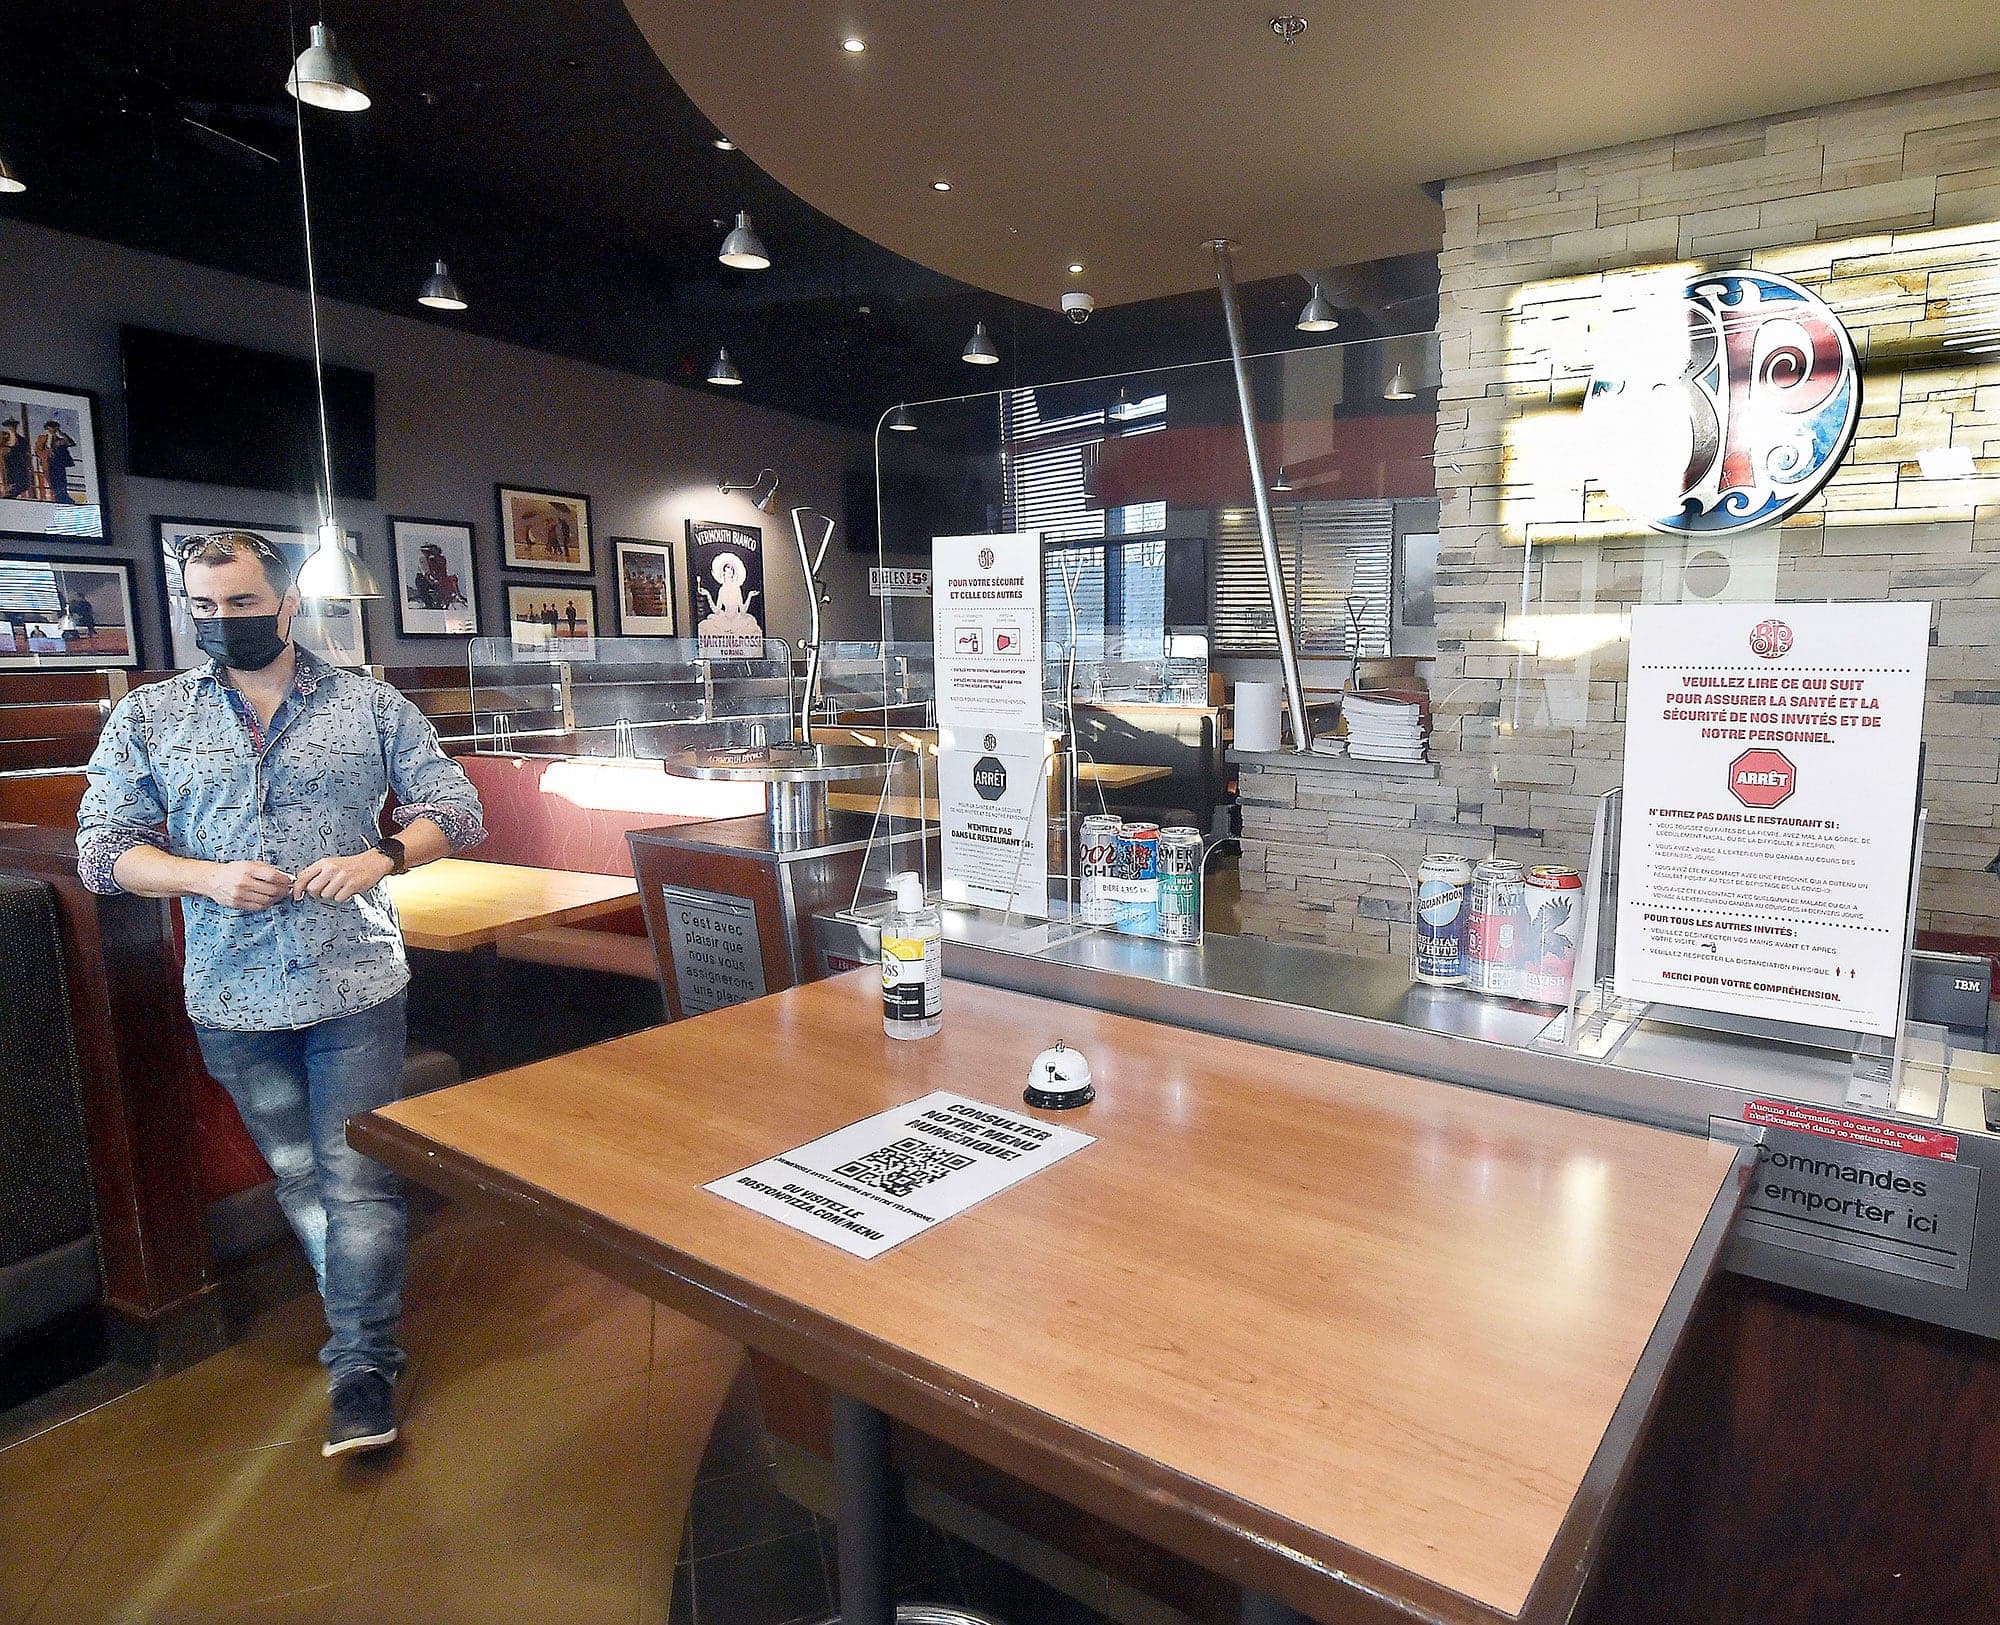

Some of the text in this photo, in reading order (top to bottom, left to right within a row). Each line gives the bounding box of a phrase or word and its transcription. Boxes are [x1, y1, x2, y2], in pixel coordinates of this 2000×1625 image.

[696, 529, 756, 551] VERMOUTH BIANCO
[992, 576, 1024, 586] SÉCURITÉ
[1682, 677, 1864, 691] VEUILLEZ LIRE CE QUI SUIT
[1666, 693, 1879, 709] POUR ASSURER LA SANTÉ ET LA
[1663, 708, 1881, 727] SÉCURITÉ DE NOS INVITÉS ET DE
[1702, 728, 1835, 743] NOTRE PERSONNEL.
[975, 770, 1005, 787] ARRÊT
[1736, 770, 1788, 786] ARRÊT
[1696, 812, 1714, 820] PAS
[1716, 813, 1742, 822] DANS
[1744, 815, 1755, 823] LE
[1757, 816, 1822, 828] RESTAURANT
[1824, 821, 1834, 829] SI
[952, 830, 968, 839] DANS
[978, 834, 1020, 846] RESTAURANT
[681, 912, 743, 936] C'est avec
[1644, 913, 1792, 937] POUR TOUS LES AUTRES INVITÉS
[686, 931, 743, 954] plaisir que
[1418, 943, 1458, 956] WHITE
[1651, 928, 1683, 936] VEUILLEZ
[1750, 939, 1773, 947] MAINS
[1775, 942, 1799, 950] AVANT
[1651, 935, 1672, 943] VOTRE
[689, 951, 745, 972] nous vous
[1650, 948, 1681, 957] VEUILLEZ
[1683, 953, 1723, 962] RESPECTER
[1736, 958, 1790, 970] DISTANCIATION
[686, 966, 754, 991] assignerons
[1663, 971, 1840, 1001] MERCI POUR VOTRE COMPRÉHENSION.
[1954, 979, 1980, 993] IBM
[694, 983, 713, 998] une
[947, 1104, 1052, 1141] CONSULTER
[1787, 1109, 1840, 1127] information
[904, 1120, 1022, 1161] NUMÉRIQUE!
[921, 1110, 1042, 1152] NOTRE MENU
[736, 1177, 885, 1241] BOSTONPIZZA.COM/MENU
[783, 1183, 865, 1219] OU VISITEZ LE
[1765, 1183, 1938, 1234] emporter ici
